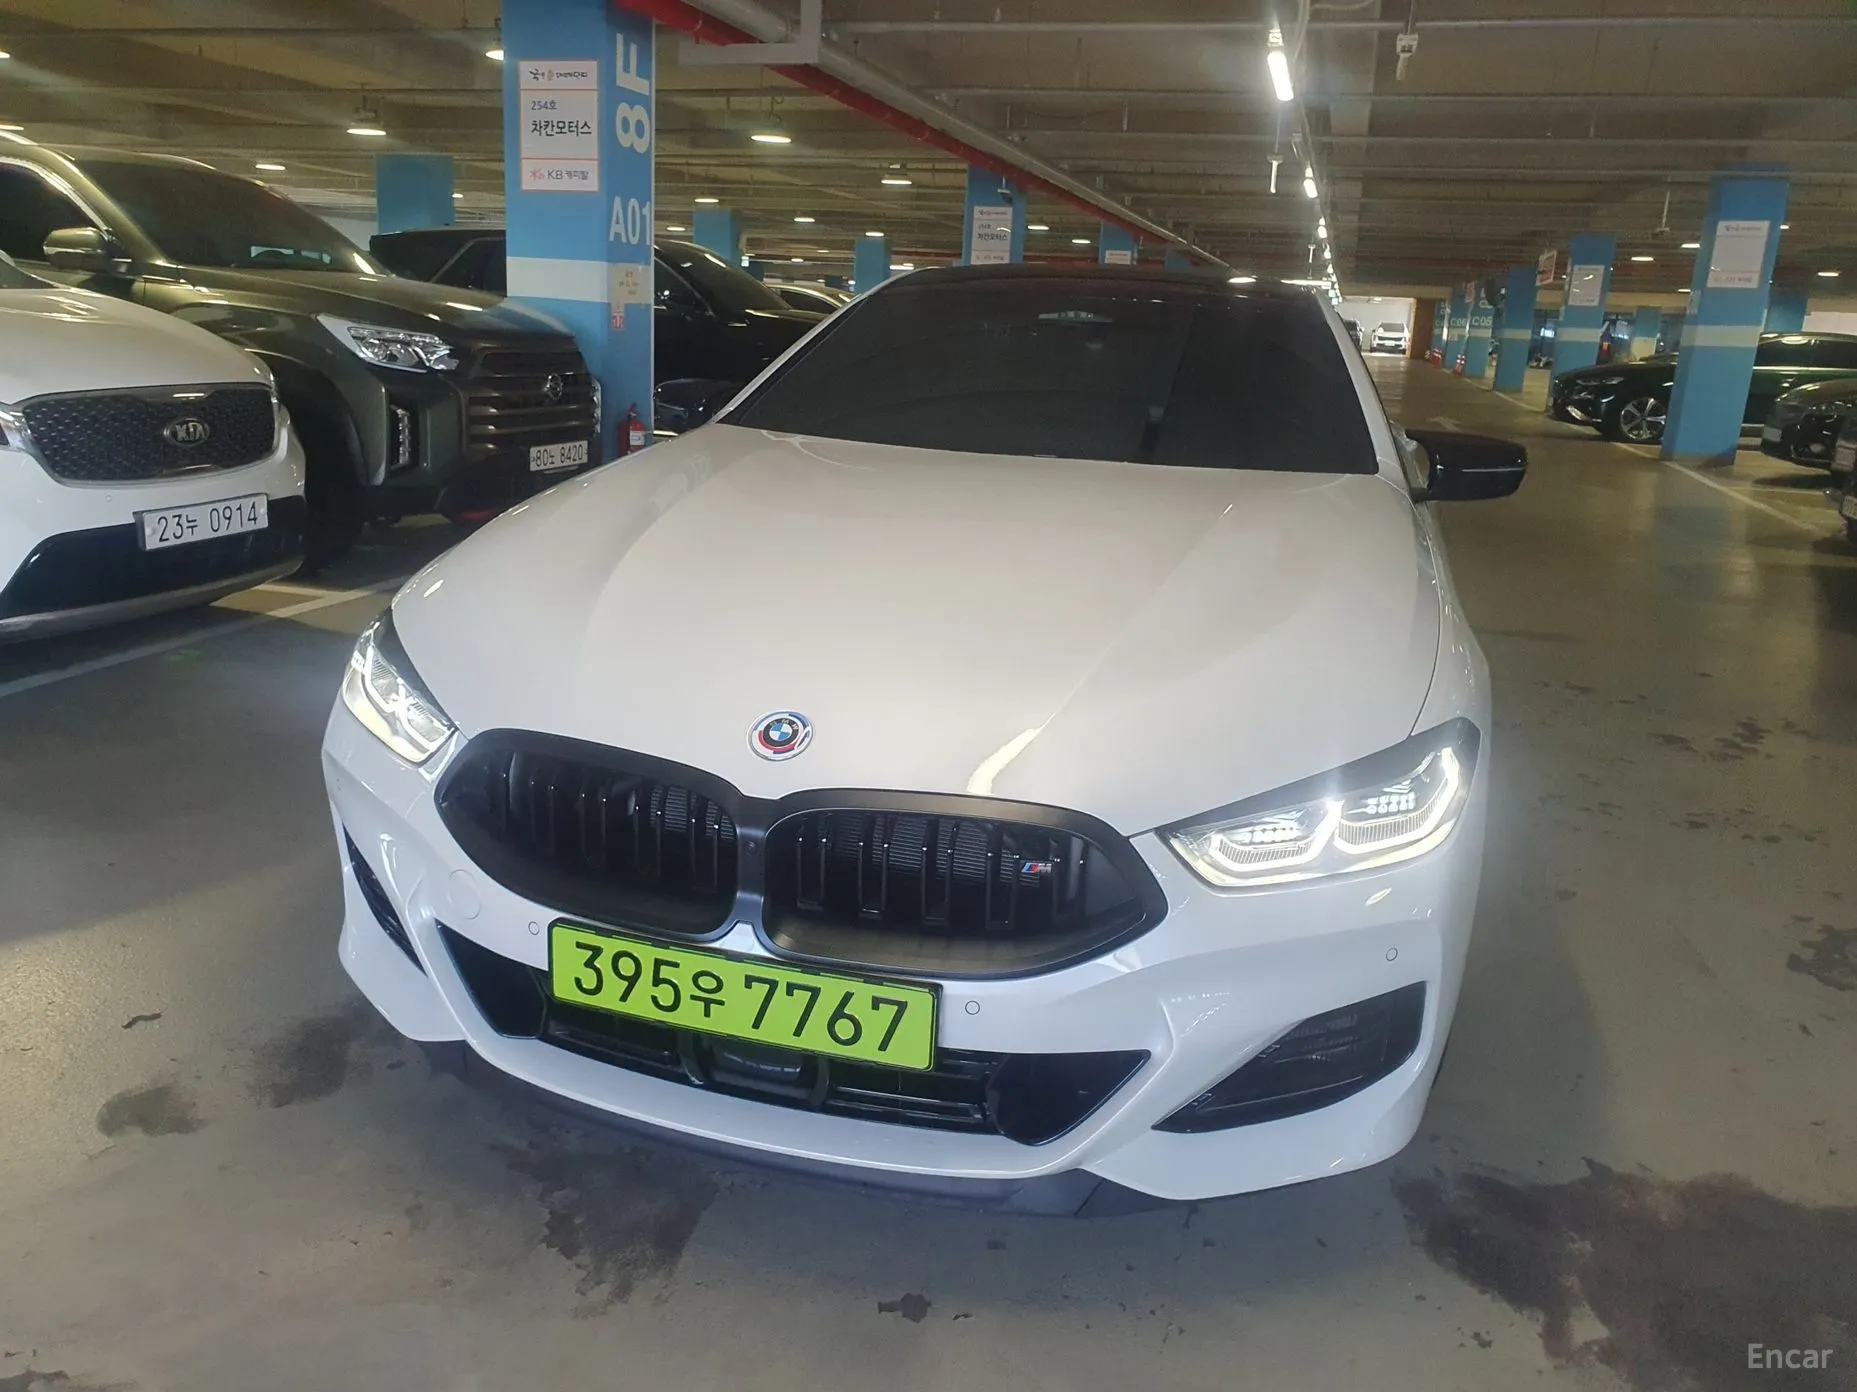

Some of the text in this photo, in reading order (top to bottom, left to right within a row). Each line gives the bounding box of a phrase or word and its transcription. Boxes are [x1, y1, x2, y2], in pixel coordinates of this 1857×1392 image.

[531, 99, 558, 111] 254호
[616, 33, 650, 153] 8F
[531, 120, 592, 137] 차칸모터스
[609, 195, 650, 245] A01
[559, 443, 584, 464] 8420
[157, 501, 258, 543] 23누 0914
[573, 940, 909, 1052] 395우 7767
